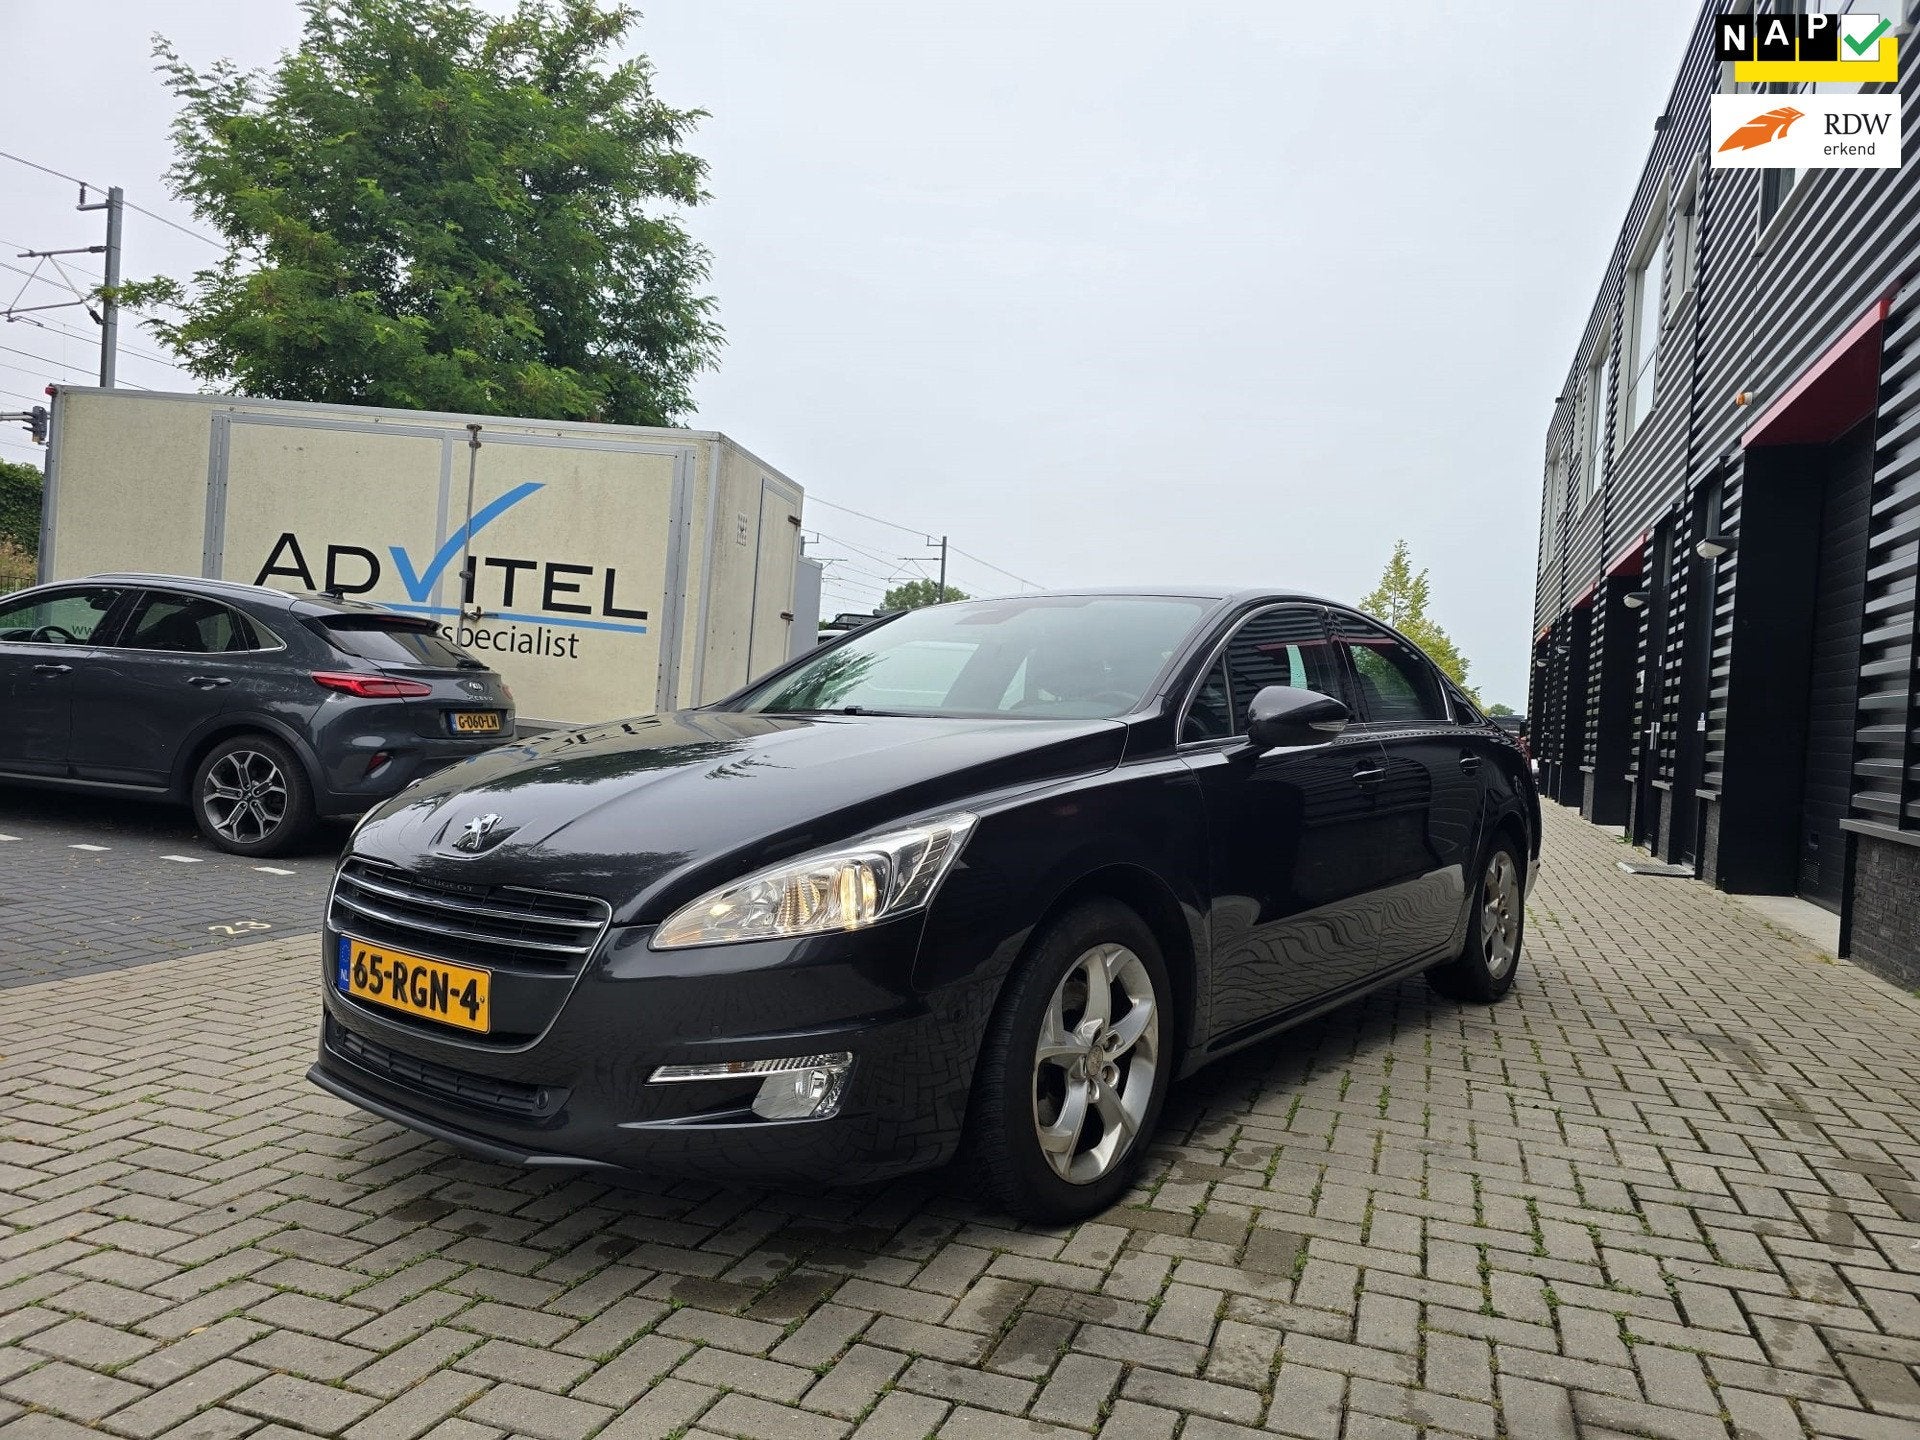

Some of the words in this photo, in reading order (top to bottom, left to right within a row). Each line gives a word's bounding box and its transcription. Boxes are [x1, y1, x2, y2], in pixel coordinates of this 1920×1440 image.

[253, 482, 649, 621] ADVITEL
[442, 625, 579, 659] specialist
[457, 714, 498, 730] G-060-LN
[208, 919, 272, 935] 23
[353, 950, 480, 1022] 65-RGN-4
